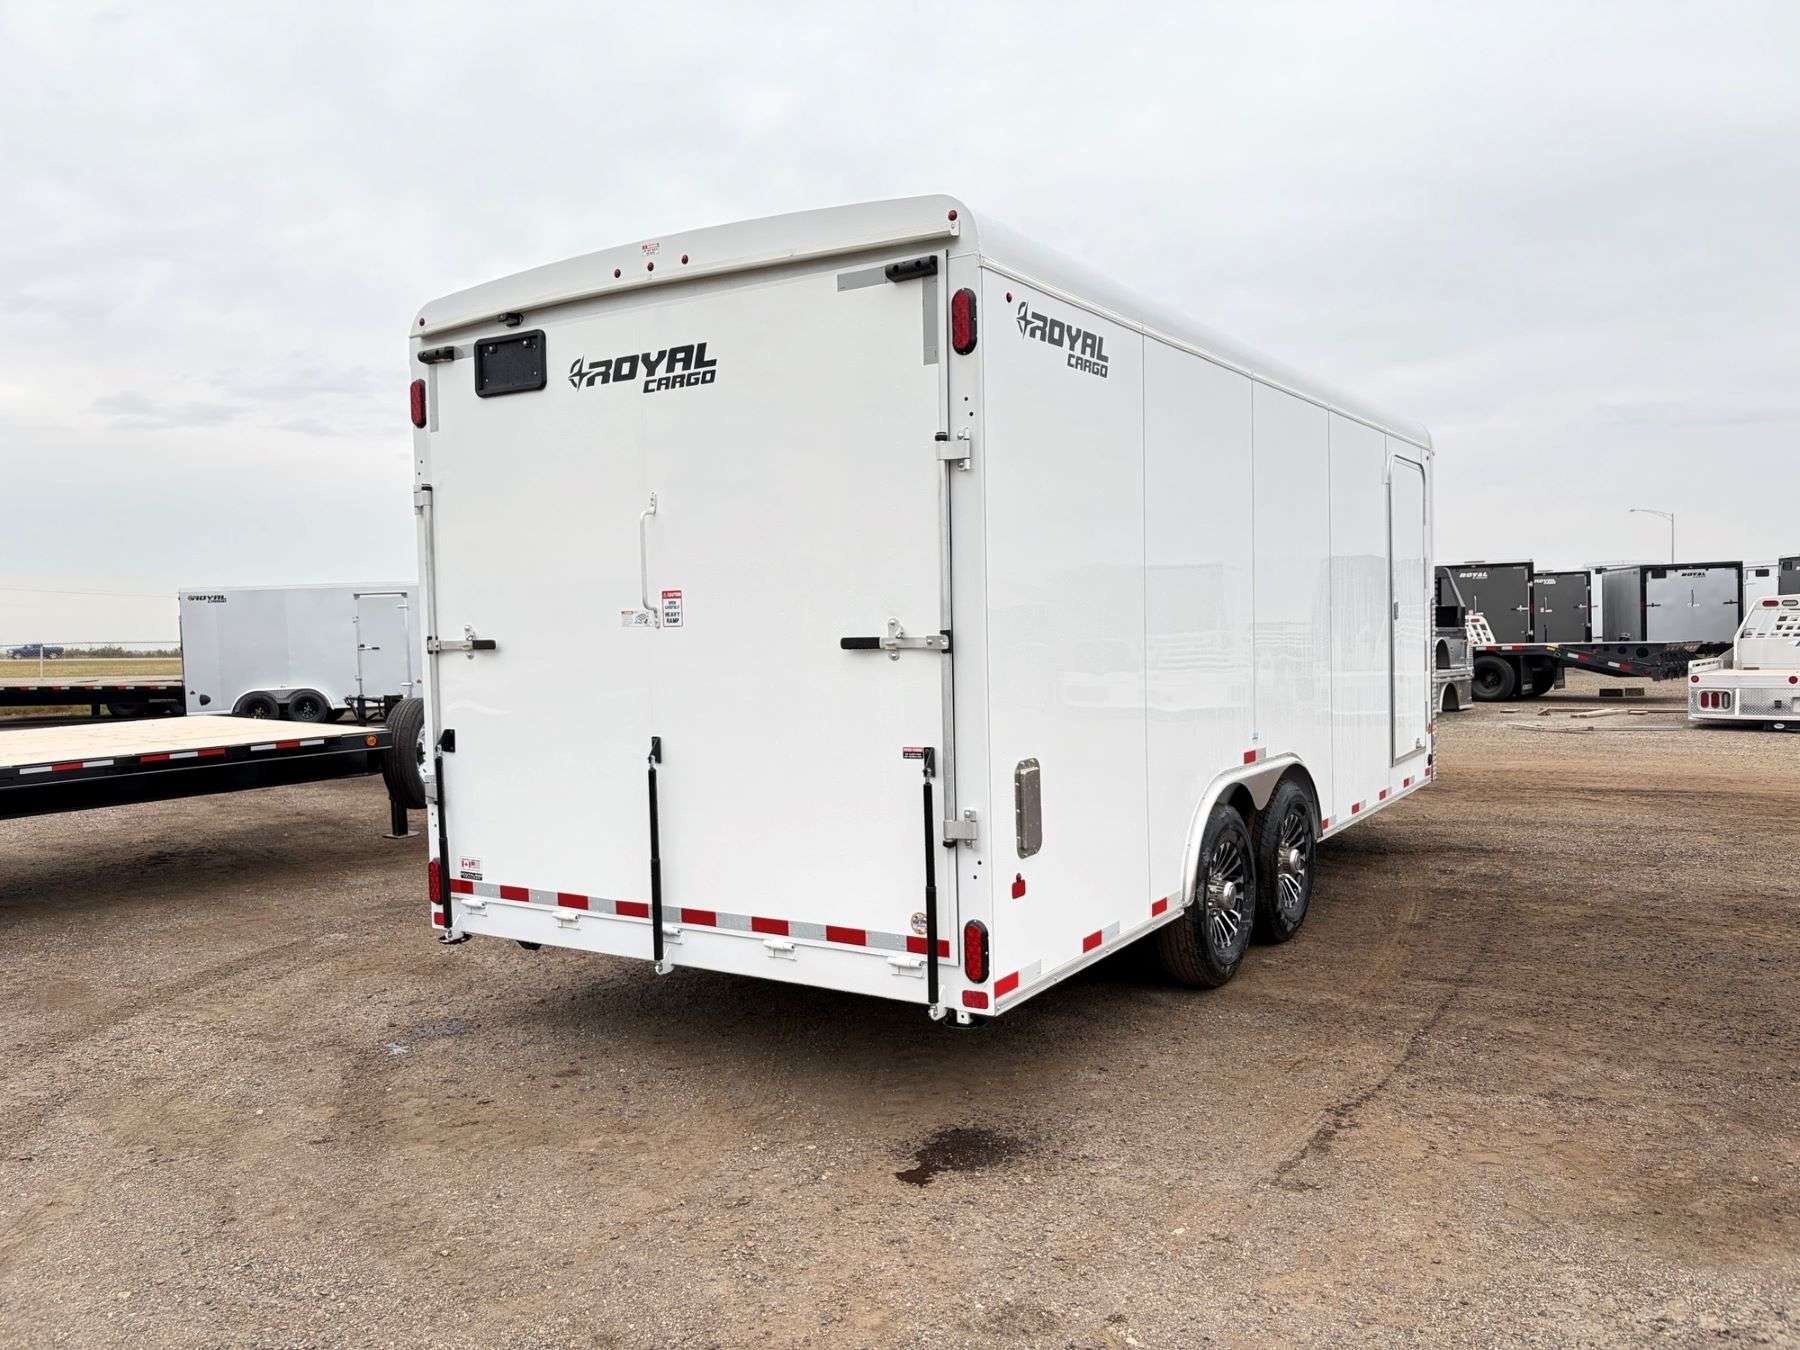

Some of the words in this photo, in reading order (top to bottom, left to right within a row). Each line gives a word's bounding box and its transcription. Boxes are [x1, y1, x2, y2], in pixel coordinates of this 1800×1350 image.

[1029, 311, 1109, 363] ROYAL
[586, 342, 717, 387] ROYAL
[643, 369, 716, 393] CARGO
[1067, 353, 1108, 378] CARGO
